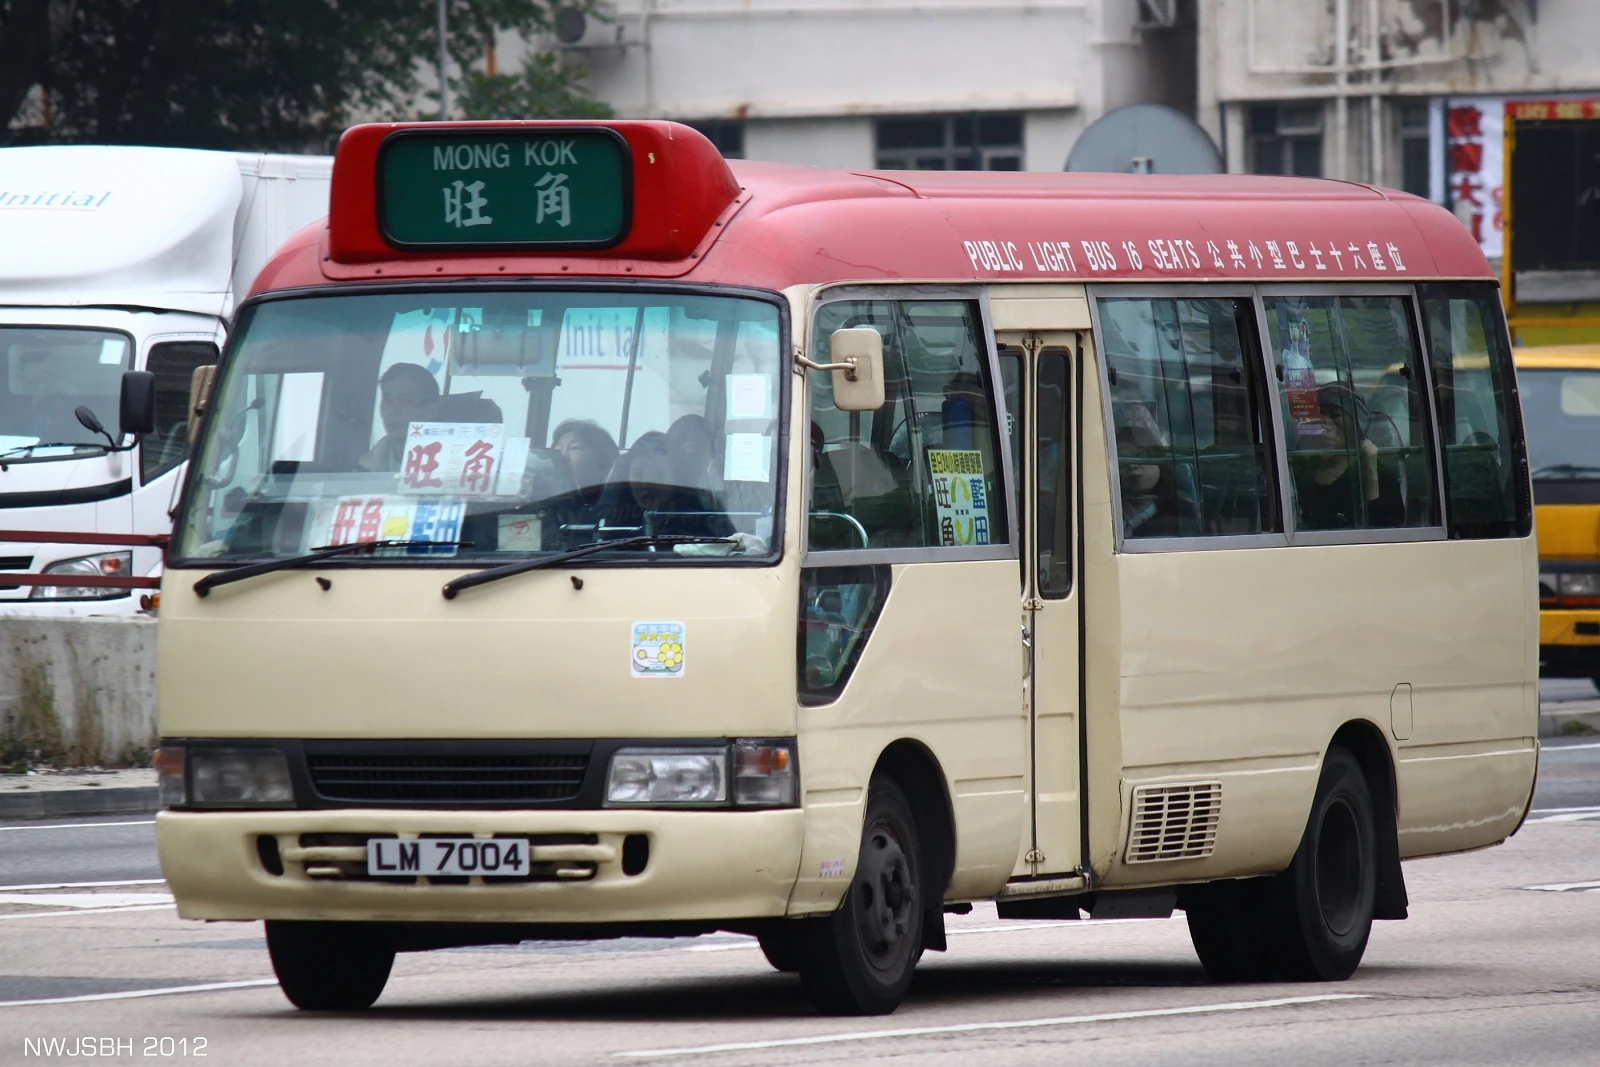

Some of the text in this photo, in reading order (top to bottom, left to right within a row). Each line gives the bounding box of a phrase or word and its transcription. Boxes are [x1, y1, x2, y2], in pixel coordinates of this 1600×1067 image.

[433, 140, 578, 170] MONG KOK
[0, 191, 111, 207] Initial
[442, 172, 571, 228] 旺角
[964, 239, 1200, 271] PUBLIC LIGHT BUS 16 SEATS
[404, 440, 495, 493] 旺角
[376, 843, 522, 871] LM 7004
